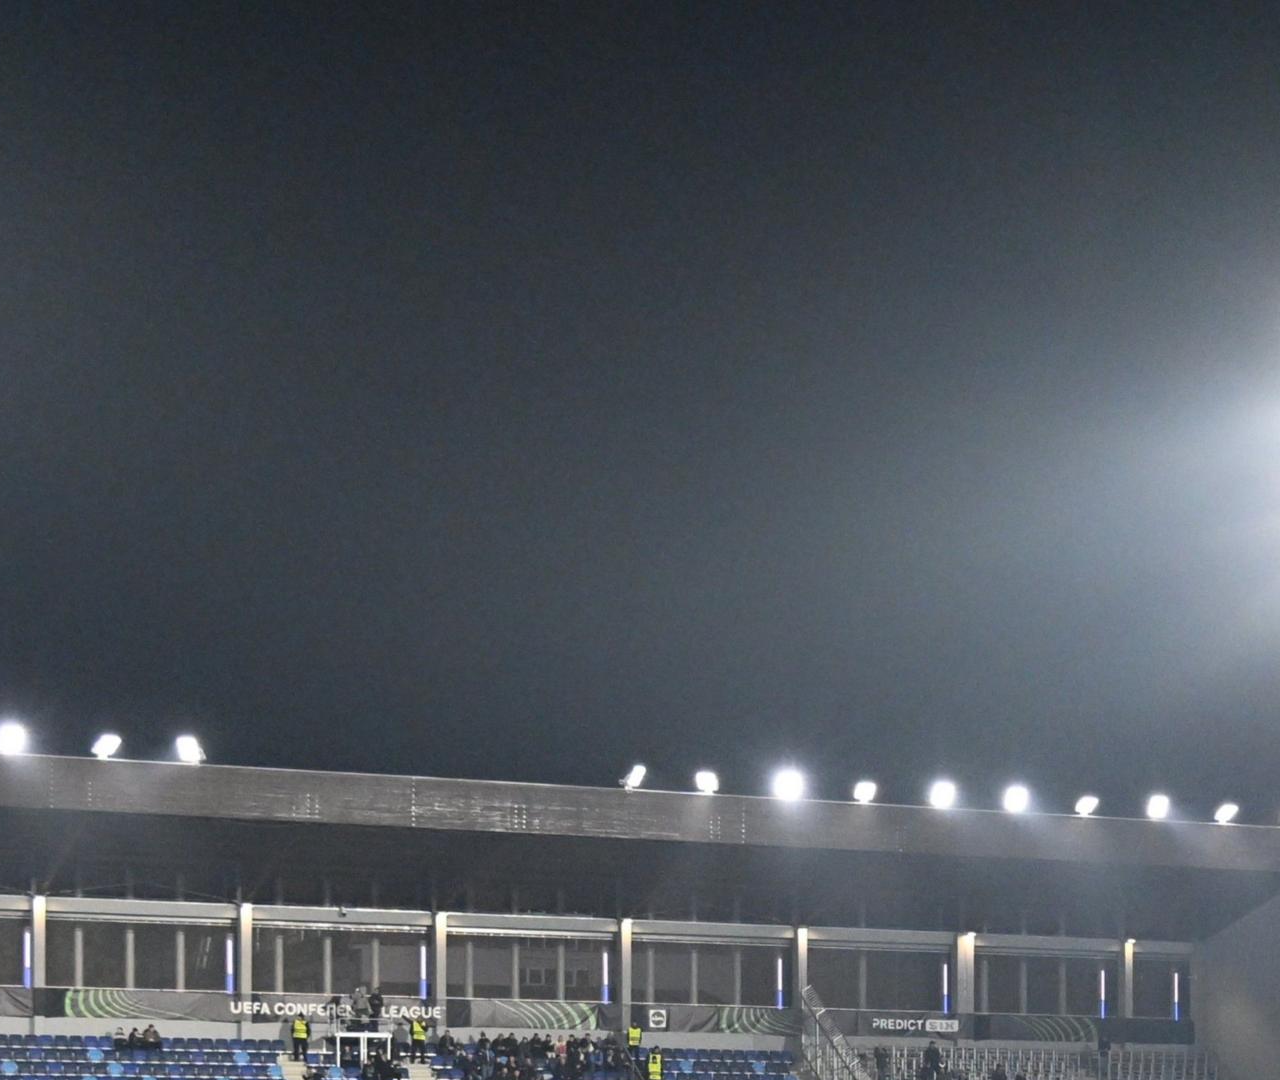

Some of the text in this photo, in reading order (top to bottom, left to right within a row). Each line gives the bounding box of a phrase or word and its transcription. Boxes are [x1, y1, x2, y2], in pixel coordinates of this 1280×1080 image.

[230, 1001, 441, 1018] UEFA CONFEREN LEAGUE
[872, 1018, 956, 1031] PREDICT SIX
